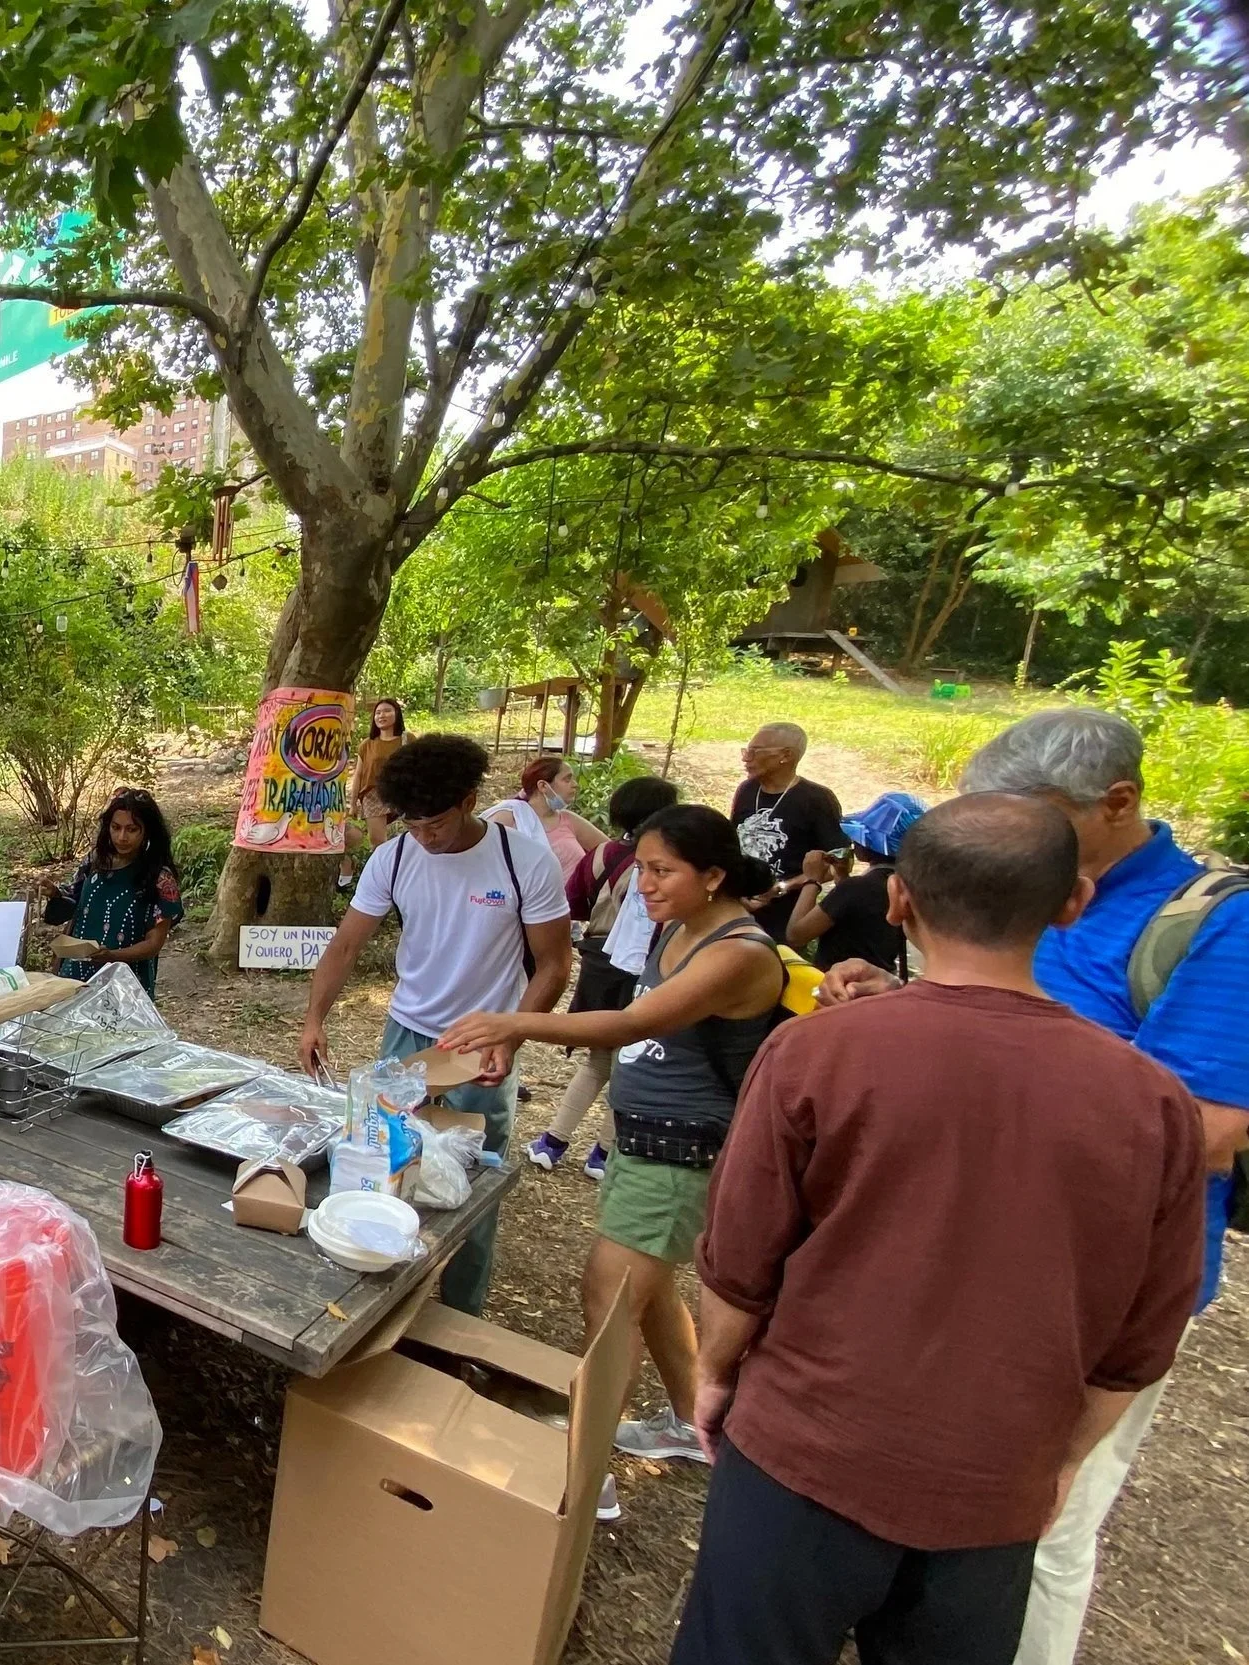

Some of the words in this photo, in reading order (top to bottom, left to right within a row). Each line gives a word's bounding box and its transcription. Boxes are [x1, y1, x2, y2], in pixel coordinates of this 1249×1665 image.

[0, 350, 19, 369] MILE
[249, 927, 278, 942] SOY
[283, 930, 298, 940] UN
[245, 943, 253, 958] Y
[255, 945, 293, 958] QUIERO
[301, 942, 328, 965] PA
[287, 958, 299, 966] LA
